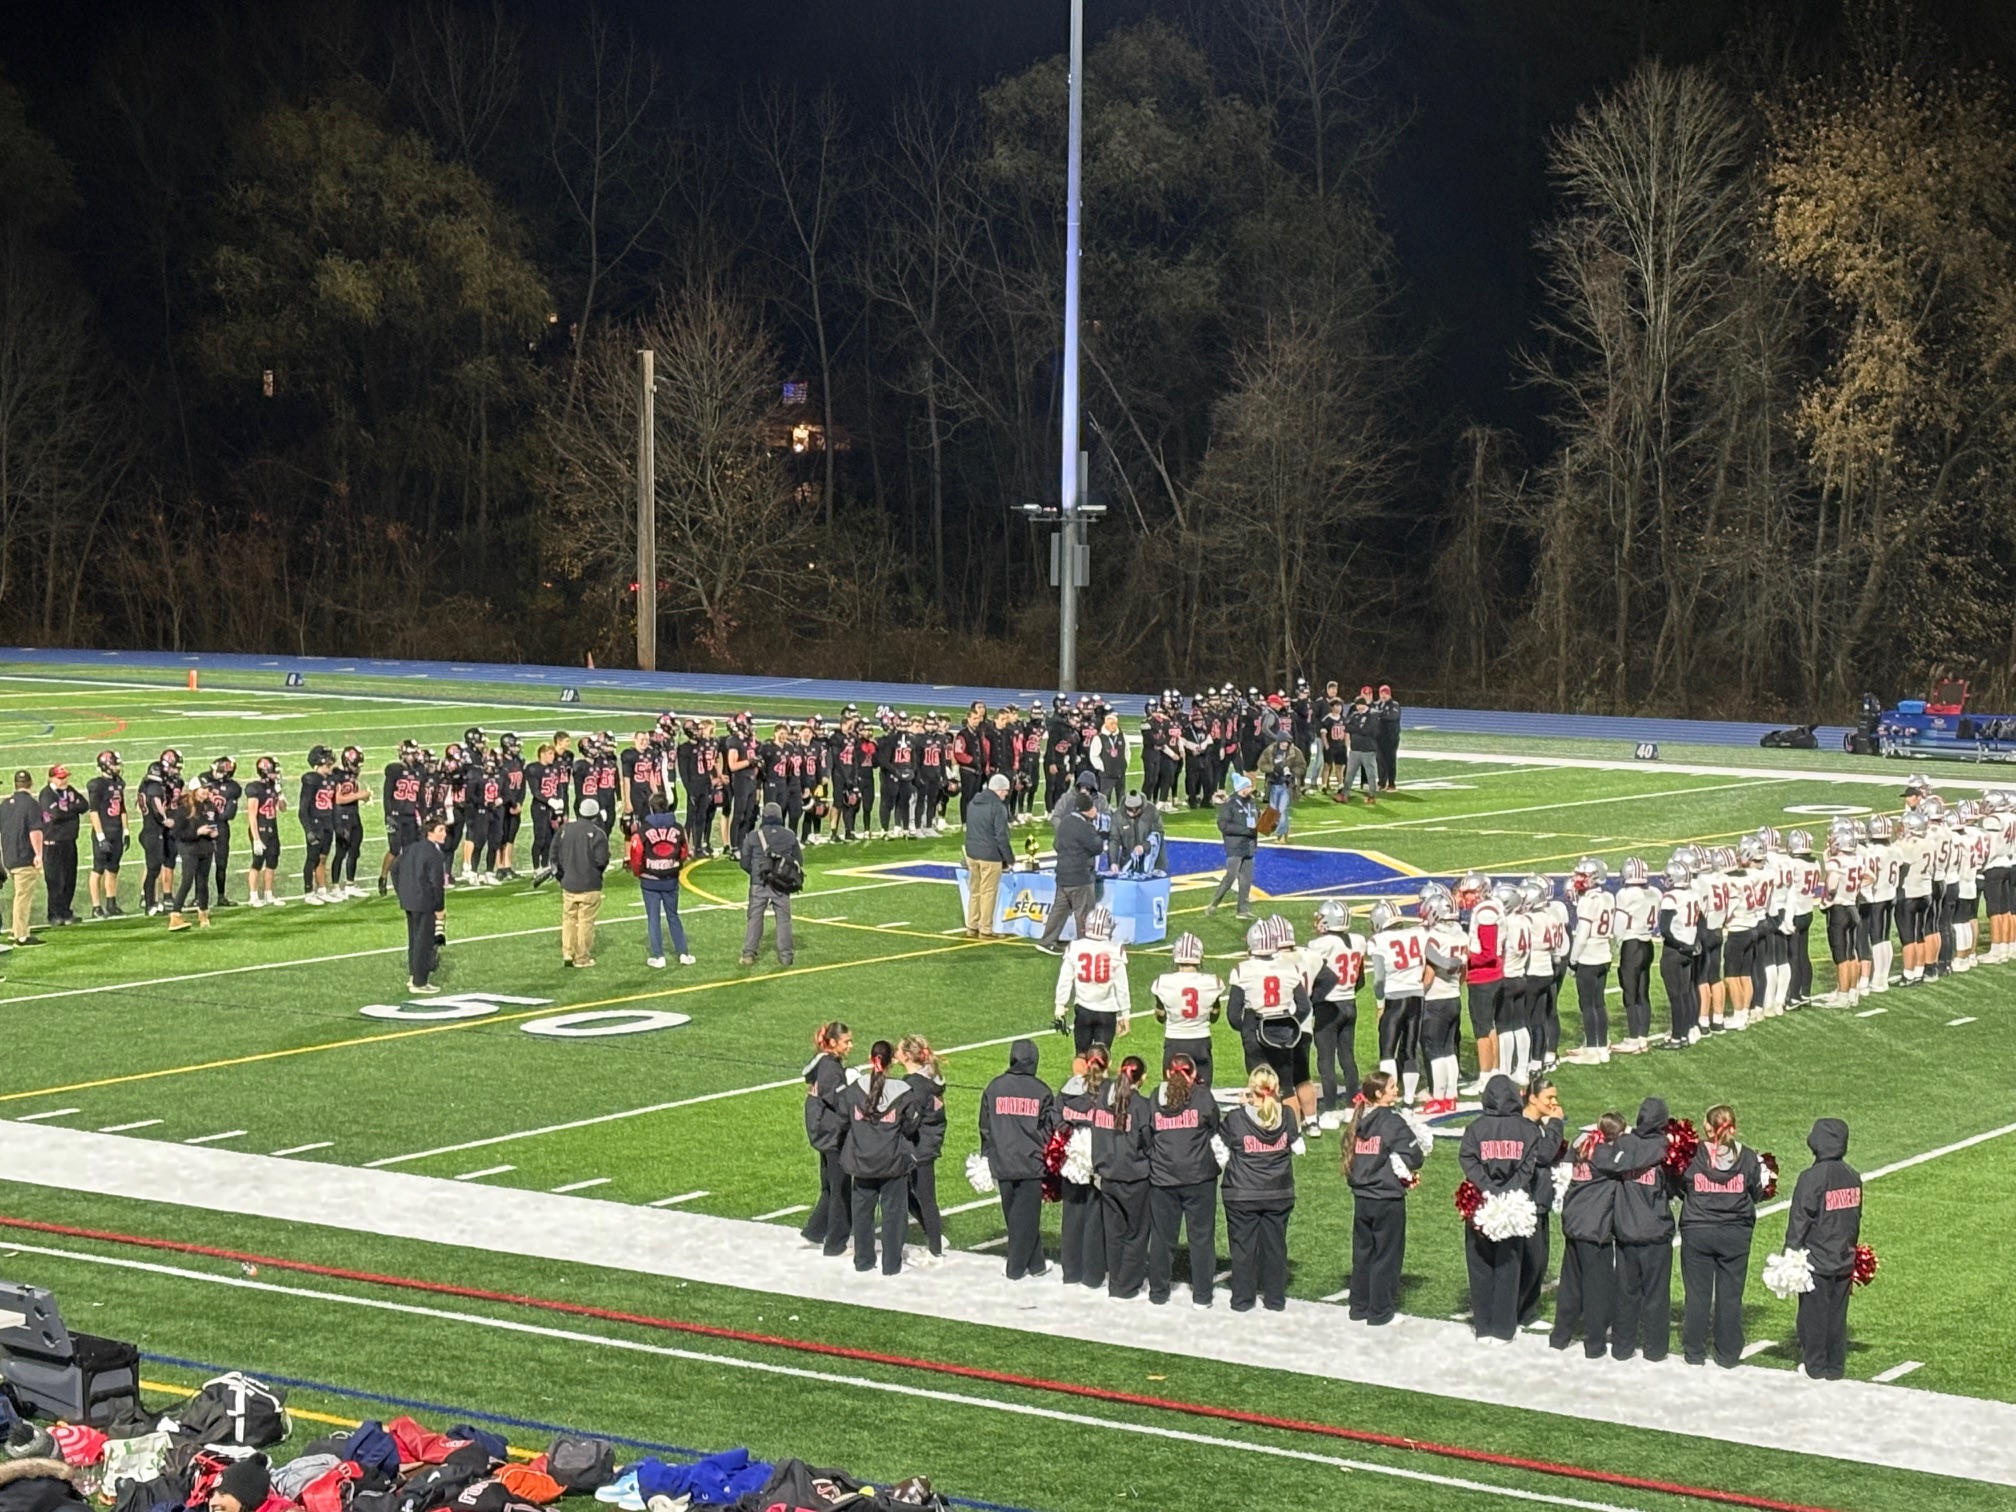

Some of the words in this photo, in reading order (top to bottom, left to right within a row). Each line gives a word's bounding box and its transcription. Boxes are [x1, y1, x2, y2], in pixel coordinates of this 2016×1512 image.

[561, 689, 574, 702] 10
[875, 705, 890, 718] 20
[1637, 744, 1653, 759] 40
[645, 826, 681, 845] RYE
[1077, 953, 1111, 983] 30
[1389, 936, 1423, 970] 34
[1335, 952, 1362, 985] 33
[1181, 987, 1199, 1019] 3
[1264, 976, 1280, 1007] 8
